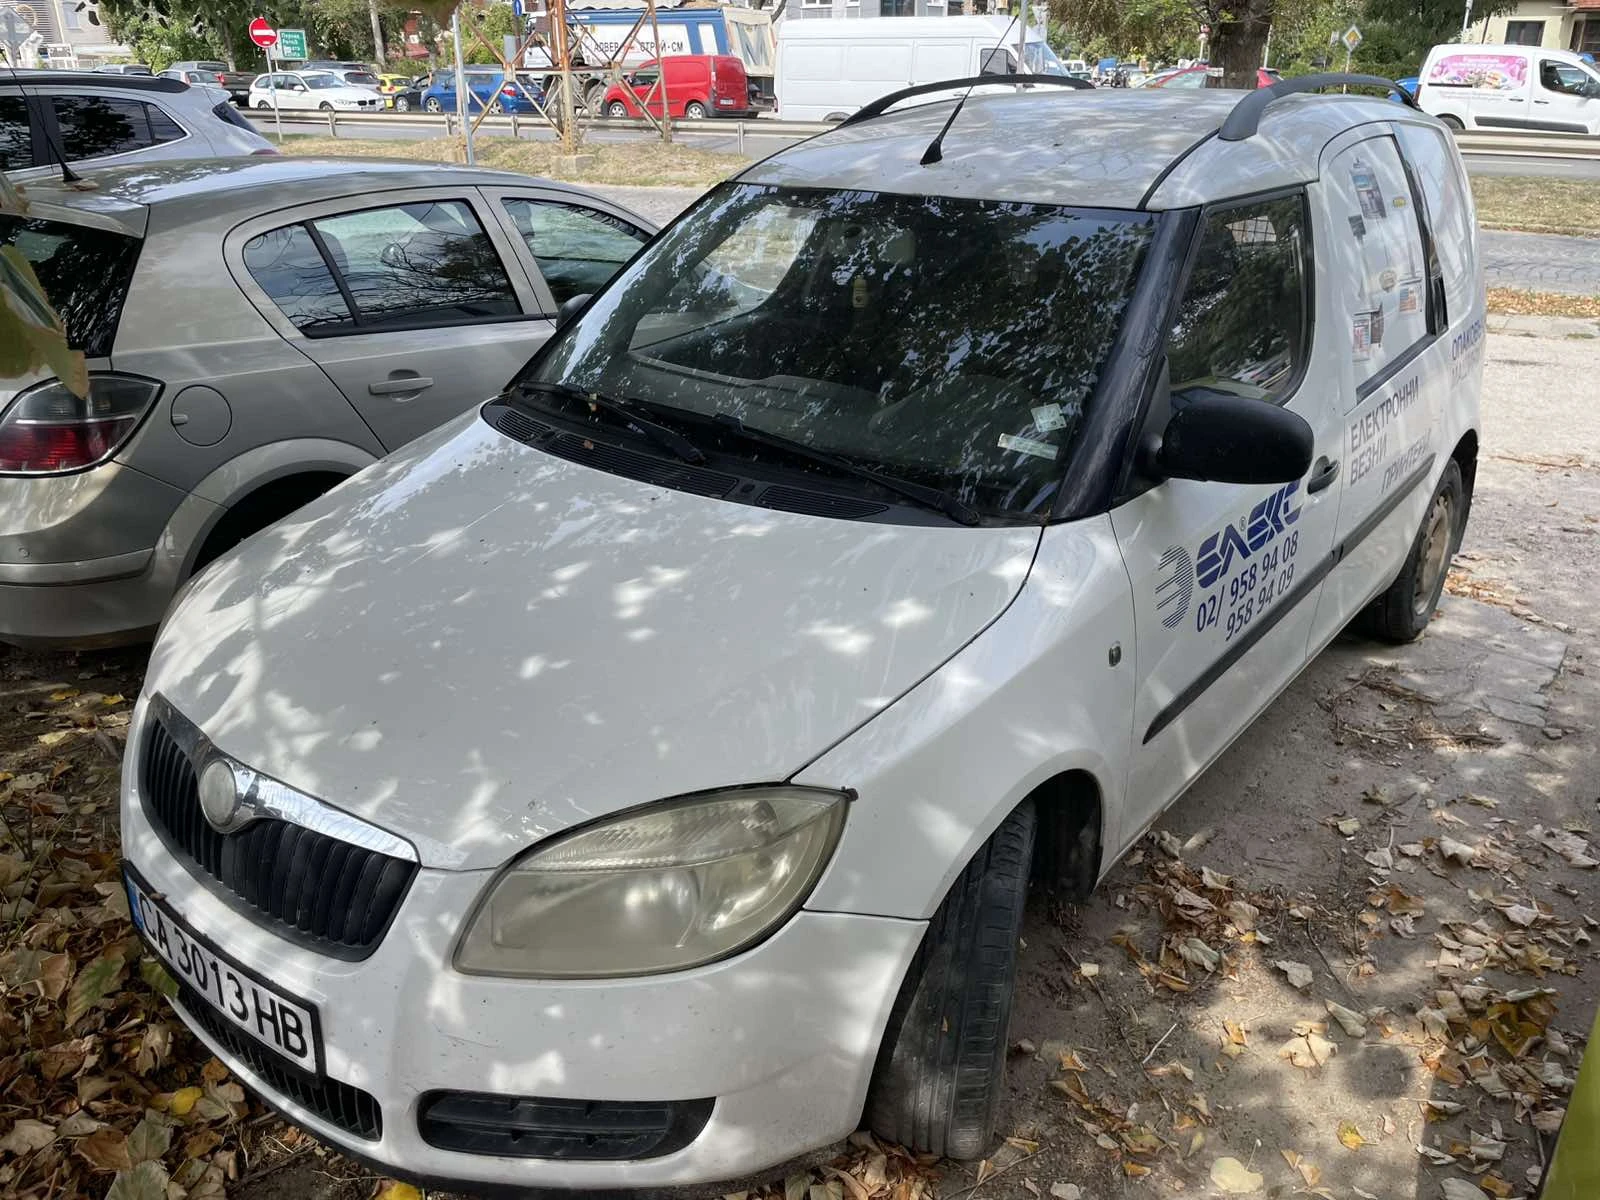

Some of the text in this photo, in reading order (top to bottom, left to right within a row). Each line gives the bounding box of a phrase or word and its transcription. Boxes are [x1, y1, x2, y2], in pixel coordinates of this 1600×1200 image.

[1351, 375, 1419, 453] ЕЛЕКТРОННИ
[1351, 434, 1387, 487] ВЕЗНИ
[1225, 563, 1294, 642] 958 94 09
[1230, 562, 1258, 608] 958
[1261, 546, 1279, 581] 94
[1282, 529, 1299, 563] 08
[174, 926, 249, 1023] 3013
[252, 987, 308, 1060] HB
